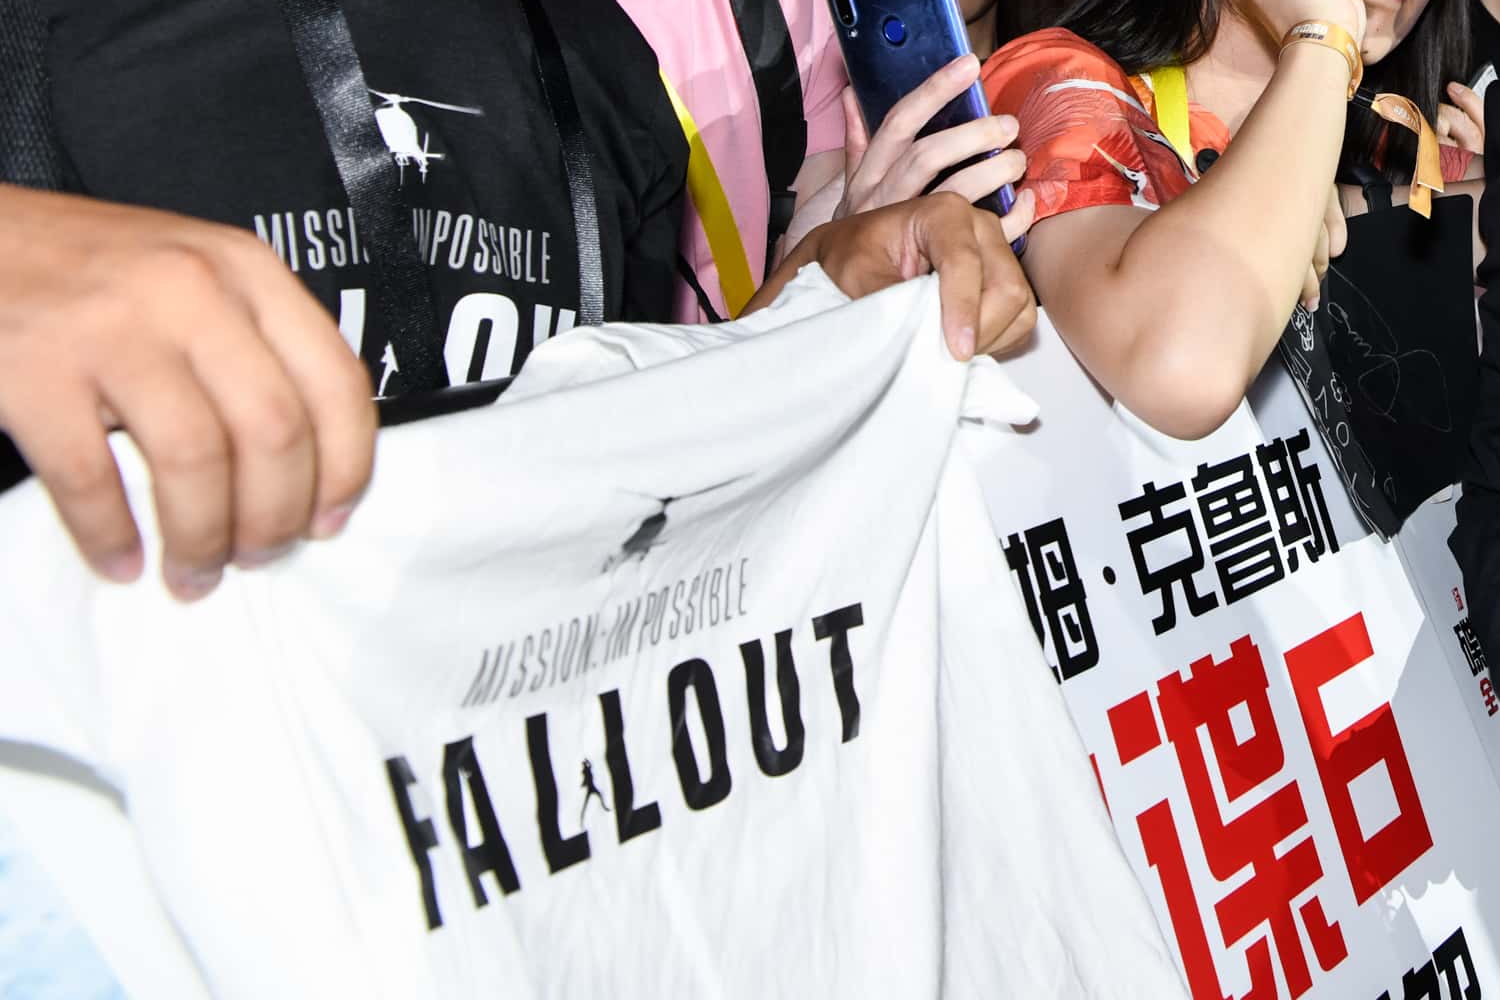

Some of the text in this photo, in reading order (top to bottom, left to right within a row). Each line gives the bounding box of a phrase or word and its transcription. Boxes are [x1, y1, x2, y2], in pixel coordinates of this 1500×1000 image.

[254, 207, 370, 272] MISSI
[384, 602, 864, 931] FALLOUT
[1089, 611, 1434, 1000] 谍6
